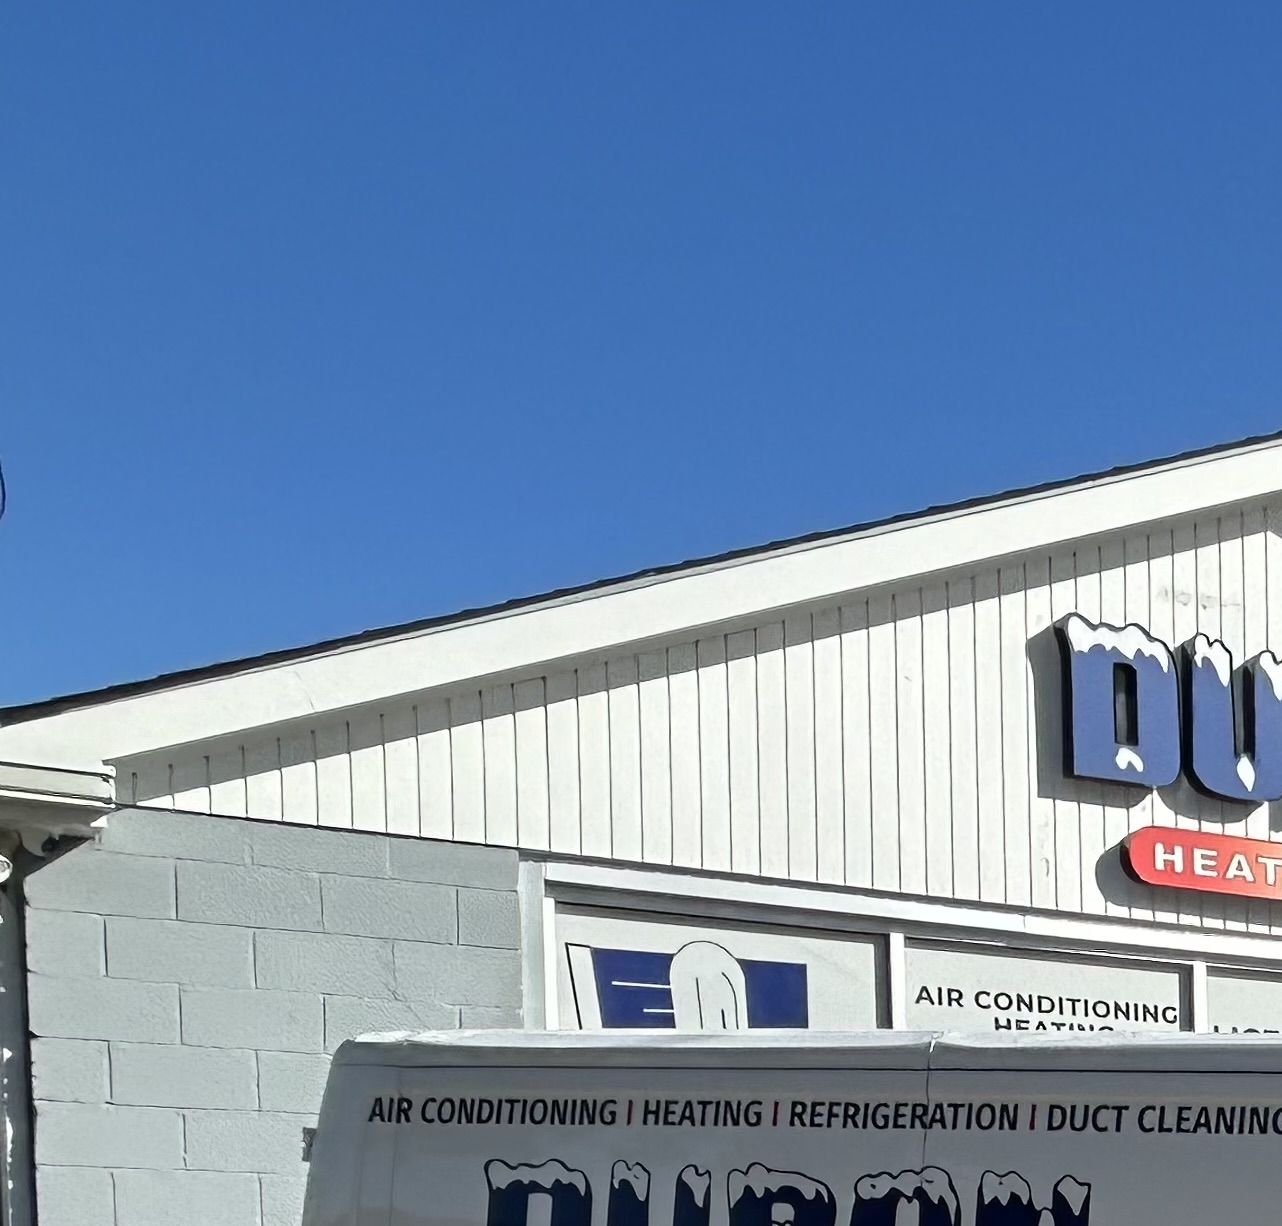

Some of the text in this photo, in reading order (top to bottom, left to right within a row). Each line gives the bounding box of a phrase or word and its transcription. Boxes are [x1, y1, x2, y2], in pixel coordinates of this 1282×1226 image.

[915, 986, 964, 1008] AIR
[973, 990, 1179, 1025] CONDITIONING
[368, 1097, 412, 1124] AIR
[420, 1097, 617, 1127] CONDITIONING
[642, 1099, 763, 1128] HEATING
[789, 1101, 1019, 1132] REFRIGERATION
[1046, 1104, 1129, 1132] DUCT
